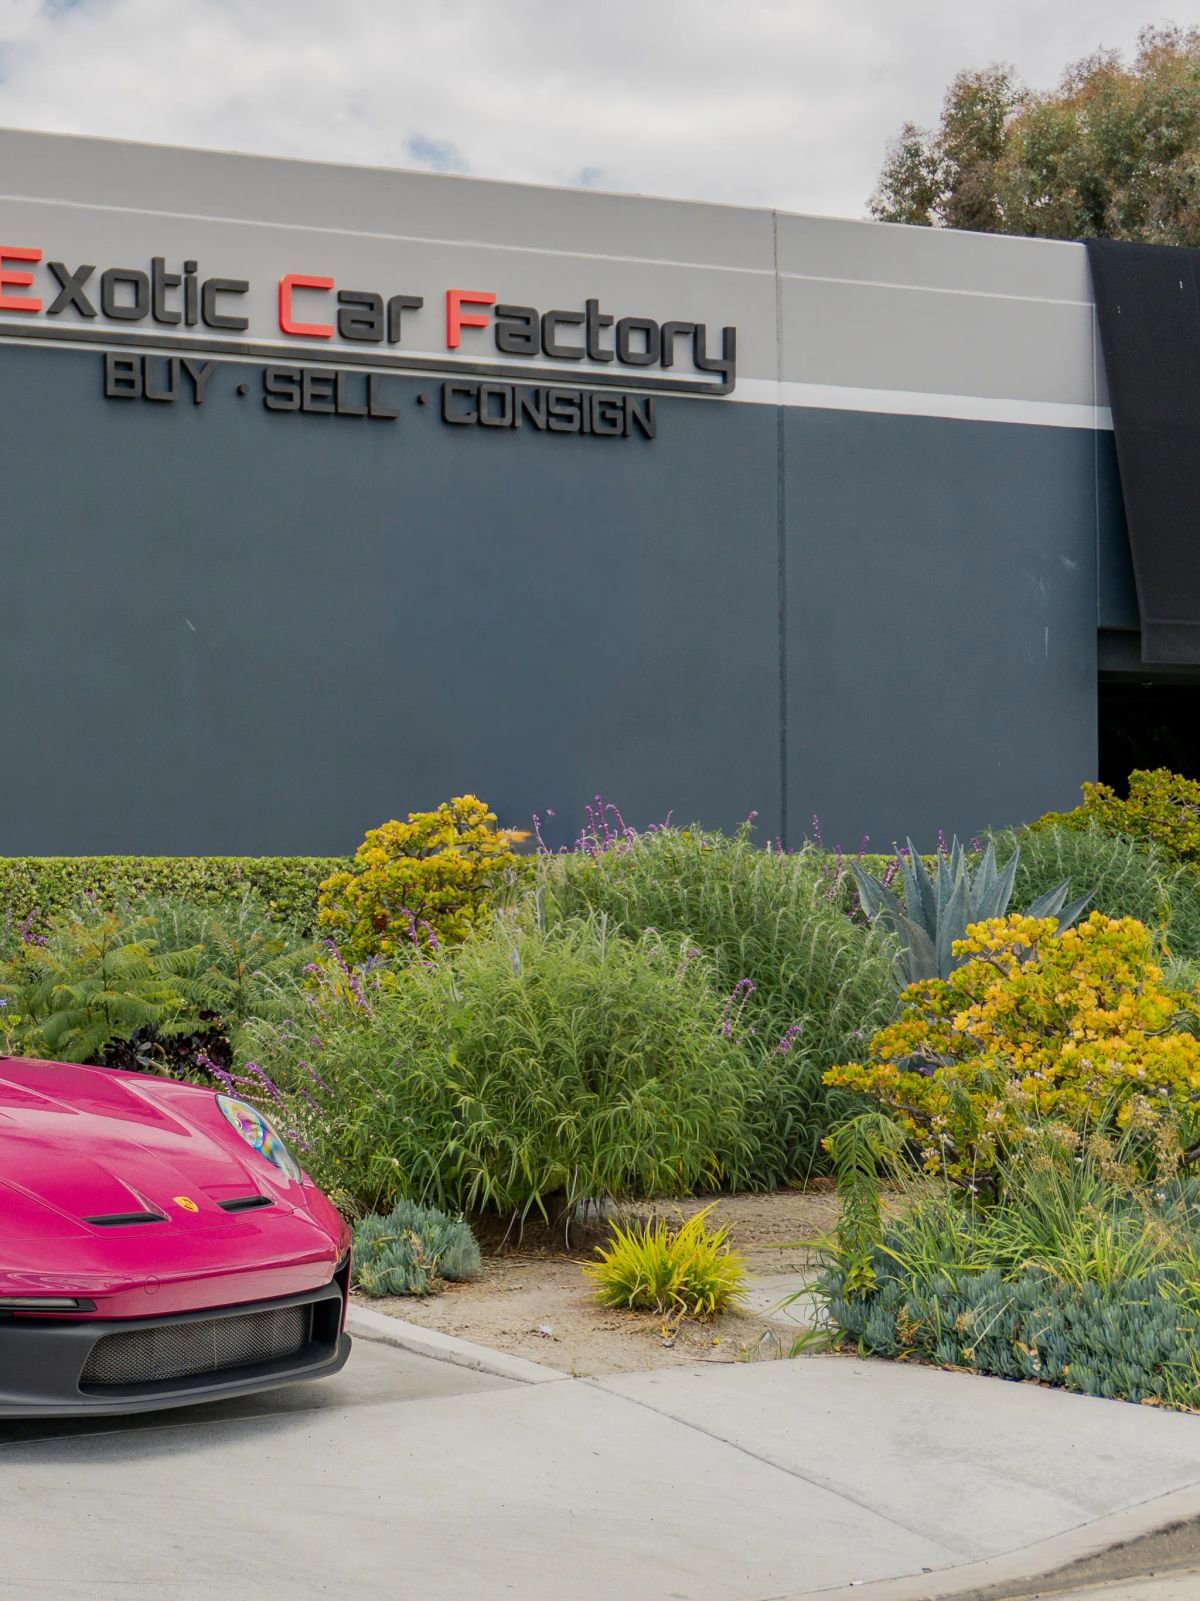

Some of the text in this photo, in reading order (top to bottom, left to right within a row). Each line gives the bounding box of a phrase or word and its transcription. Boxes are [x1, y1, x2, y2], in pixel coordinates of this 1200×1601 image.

[277, 273, 424, 344] Car
[446, 288, 737, 396] Factory
[103, 351, 657, 439] BUY SELL CONSIGN
